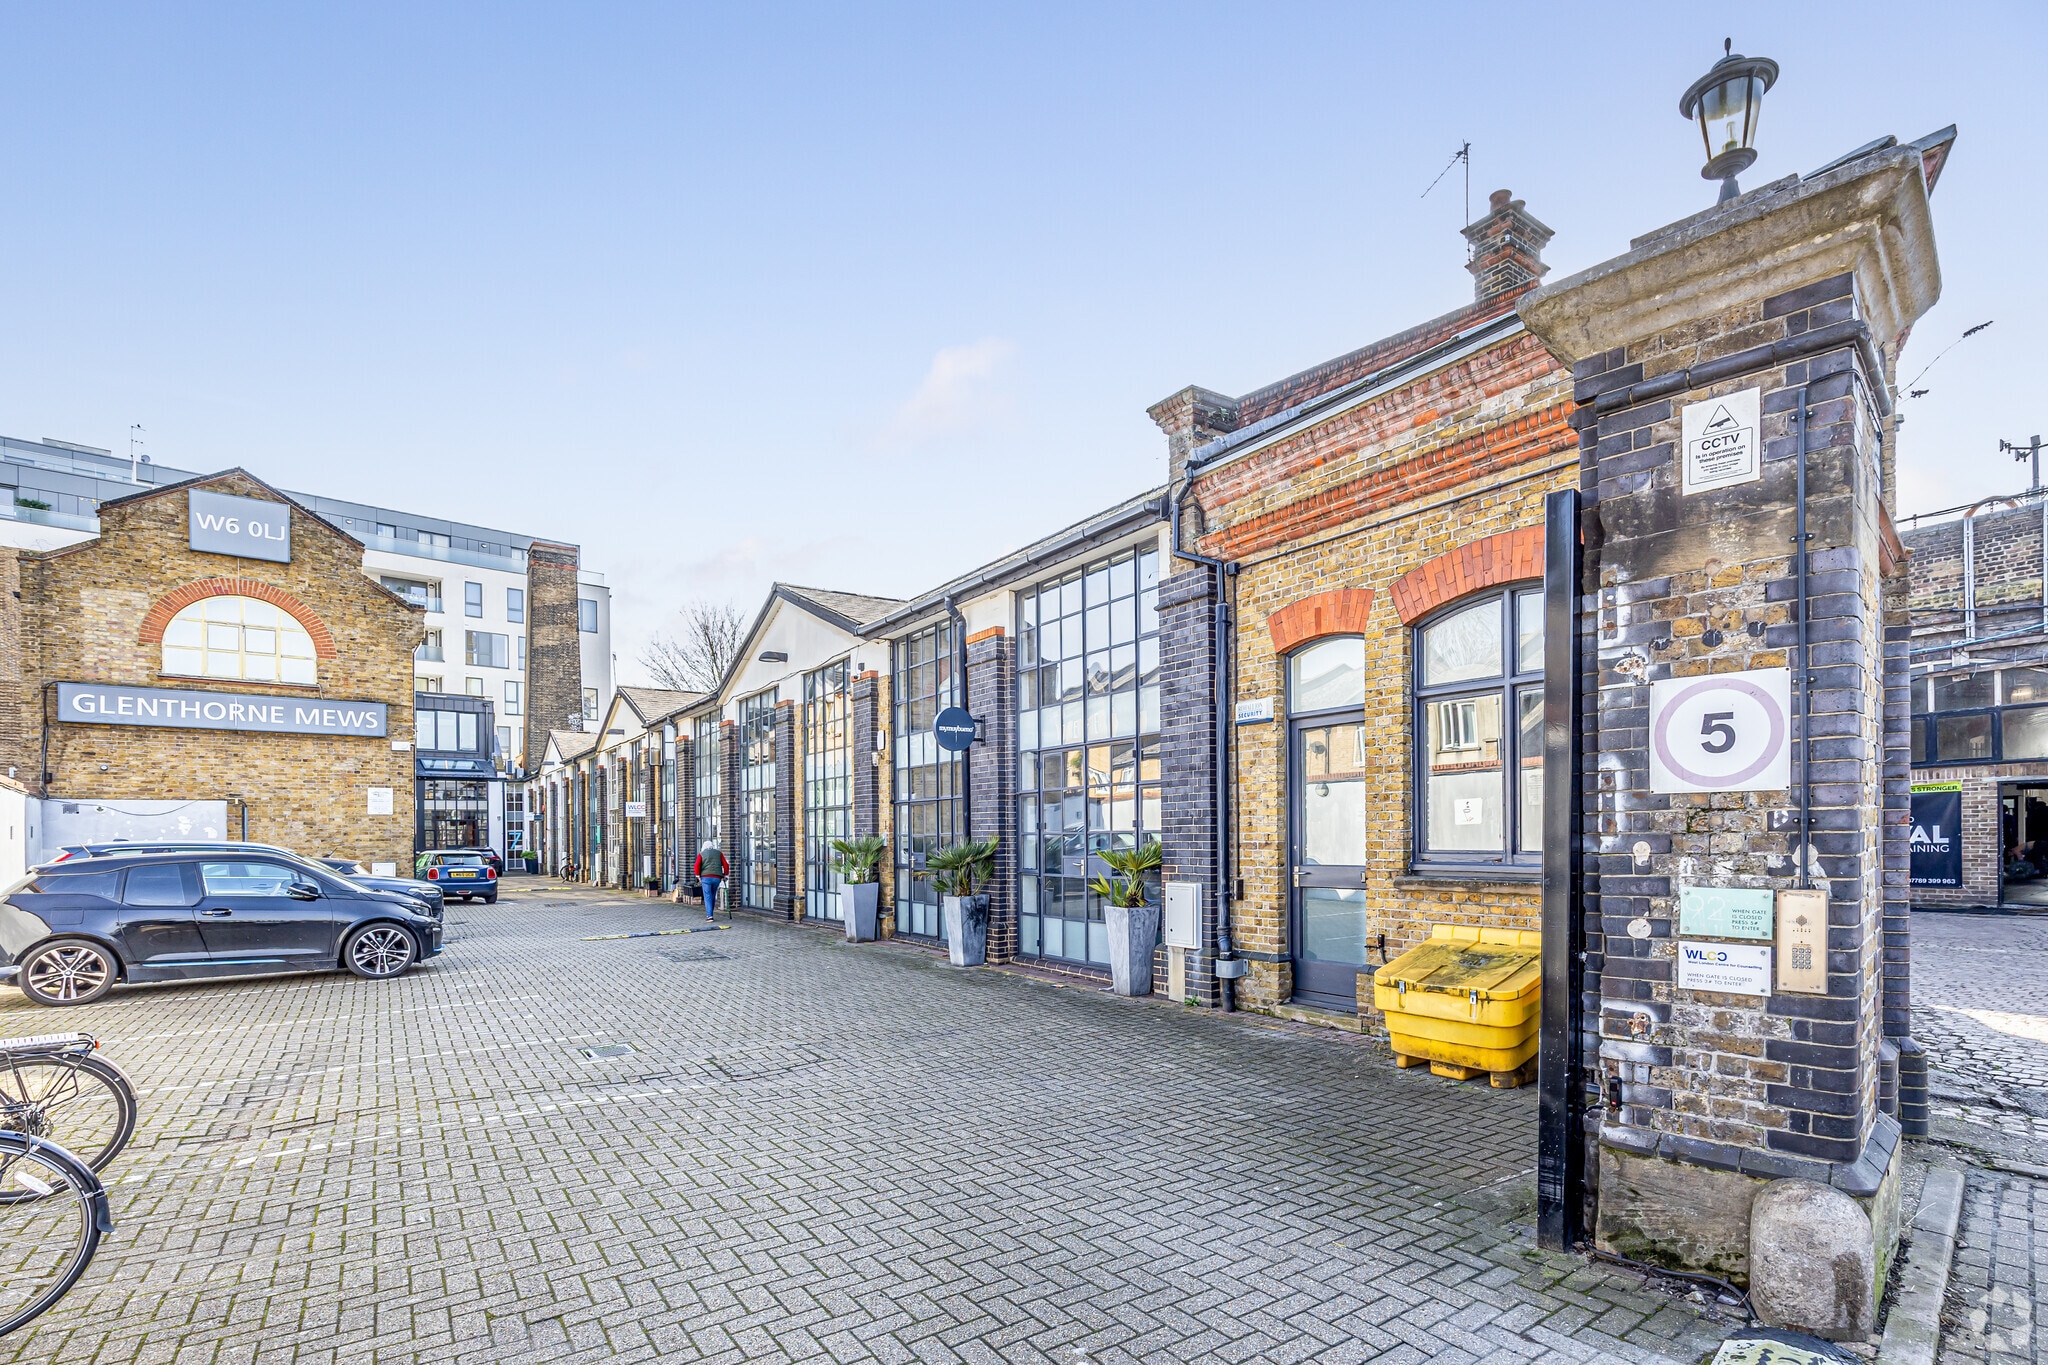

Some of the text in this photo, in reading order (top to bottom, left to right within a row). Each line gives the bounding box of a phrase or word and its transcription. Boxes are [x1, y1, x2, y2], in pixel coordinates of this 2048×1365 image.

[1702, 433, 1740, 450] CCTV
[1709, 446, 1736, 457] operation
[1716, 451, 1743, 460] premises
[196, 512, 240, 534] W6
[72, 694, 378, 728] GLENTHORNE MEWS
[1238, 710, 1262, 719] SECURITY
[1701, 712, 1736, 753] 5
[509, 832, 522, 850] 7
[1686, 896, 1726, 920] 92
